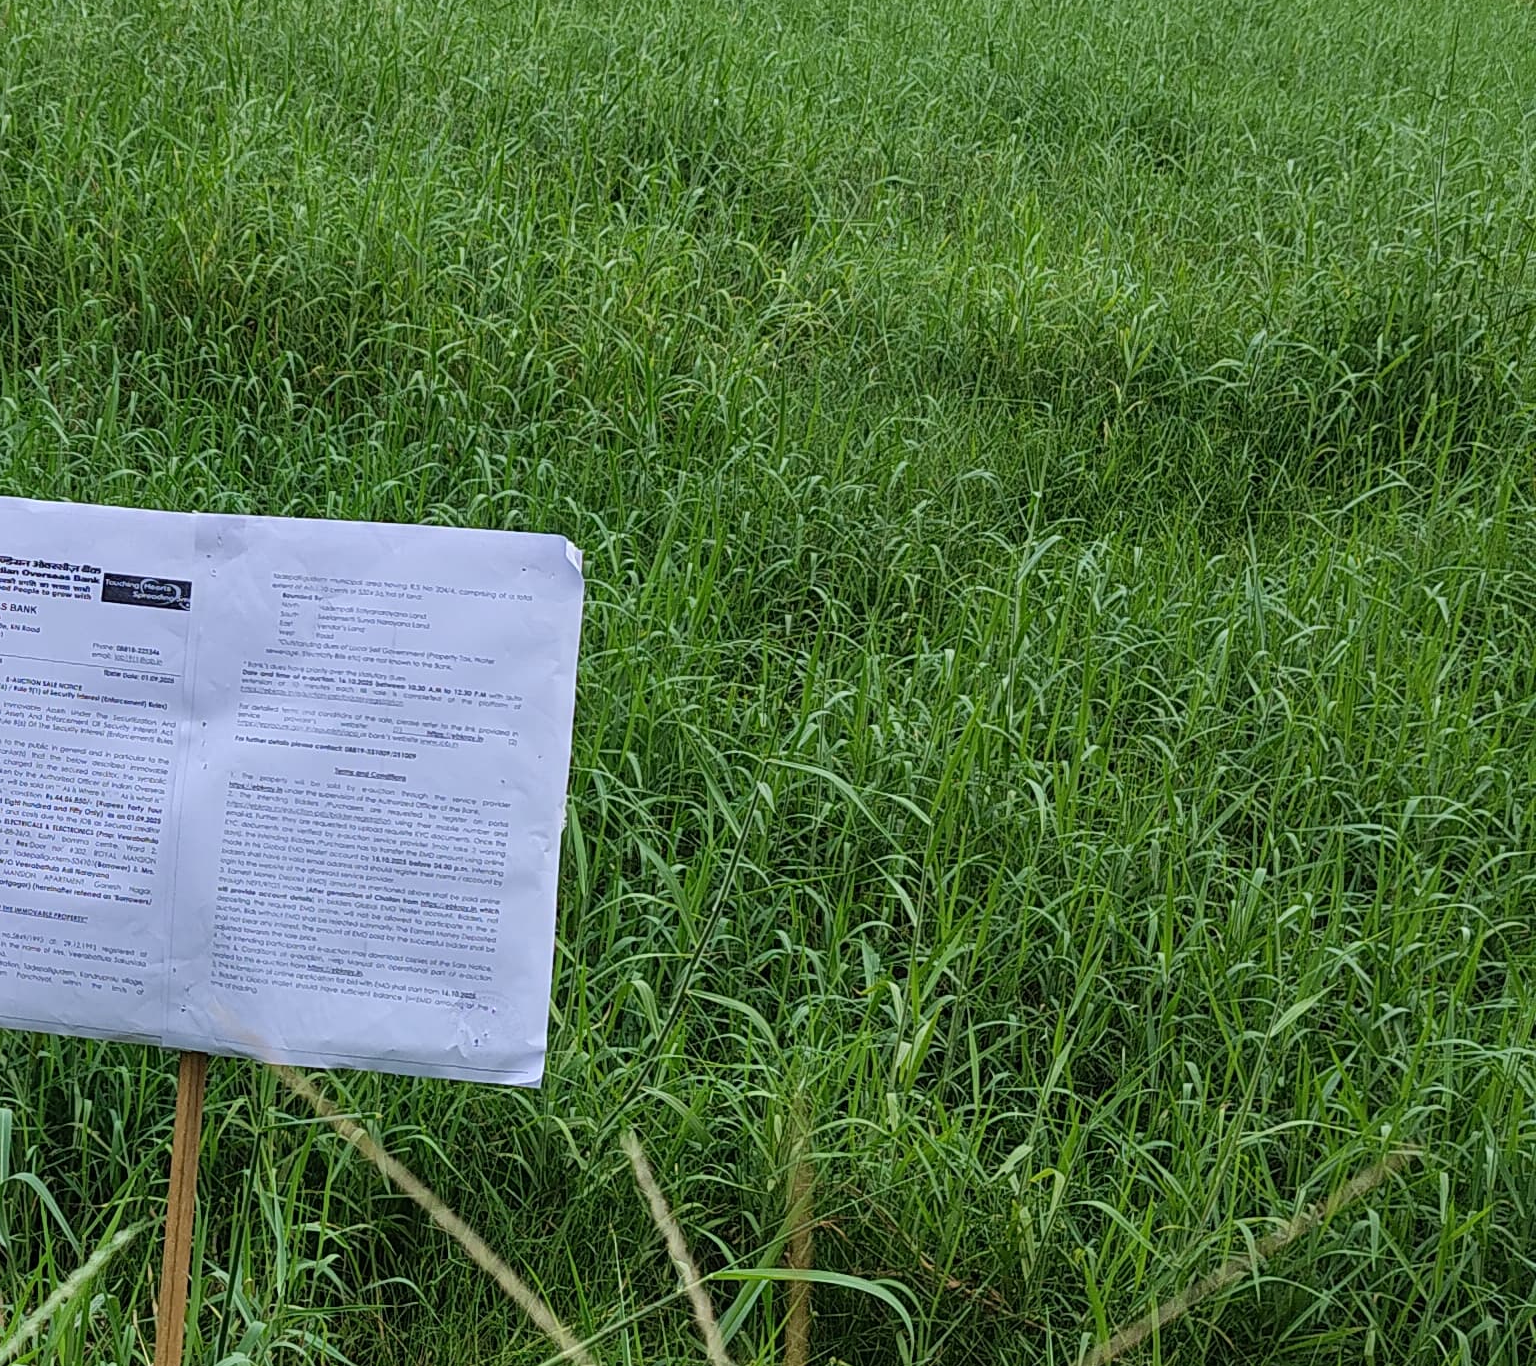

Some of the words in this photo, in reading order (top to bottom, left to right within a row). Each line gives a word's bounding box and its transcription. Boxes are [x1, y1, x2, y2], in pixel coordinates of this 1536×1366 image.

[22, 570, 71, 581] Overseas
[74, 575, 100, 584] Bank
[105, 579, 139, 589] Touching
[144, 583, 172, 591] Hearts
[13, 586, 39, 595] People
[52, 590, 72, 599] grow
[133, 591, 174, 602] Spreading
[10, 604, 37, 614] BANK
[22, 625, 40, 633] Road
